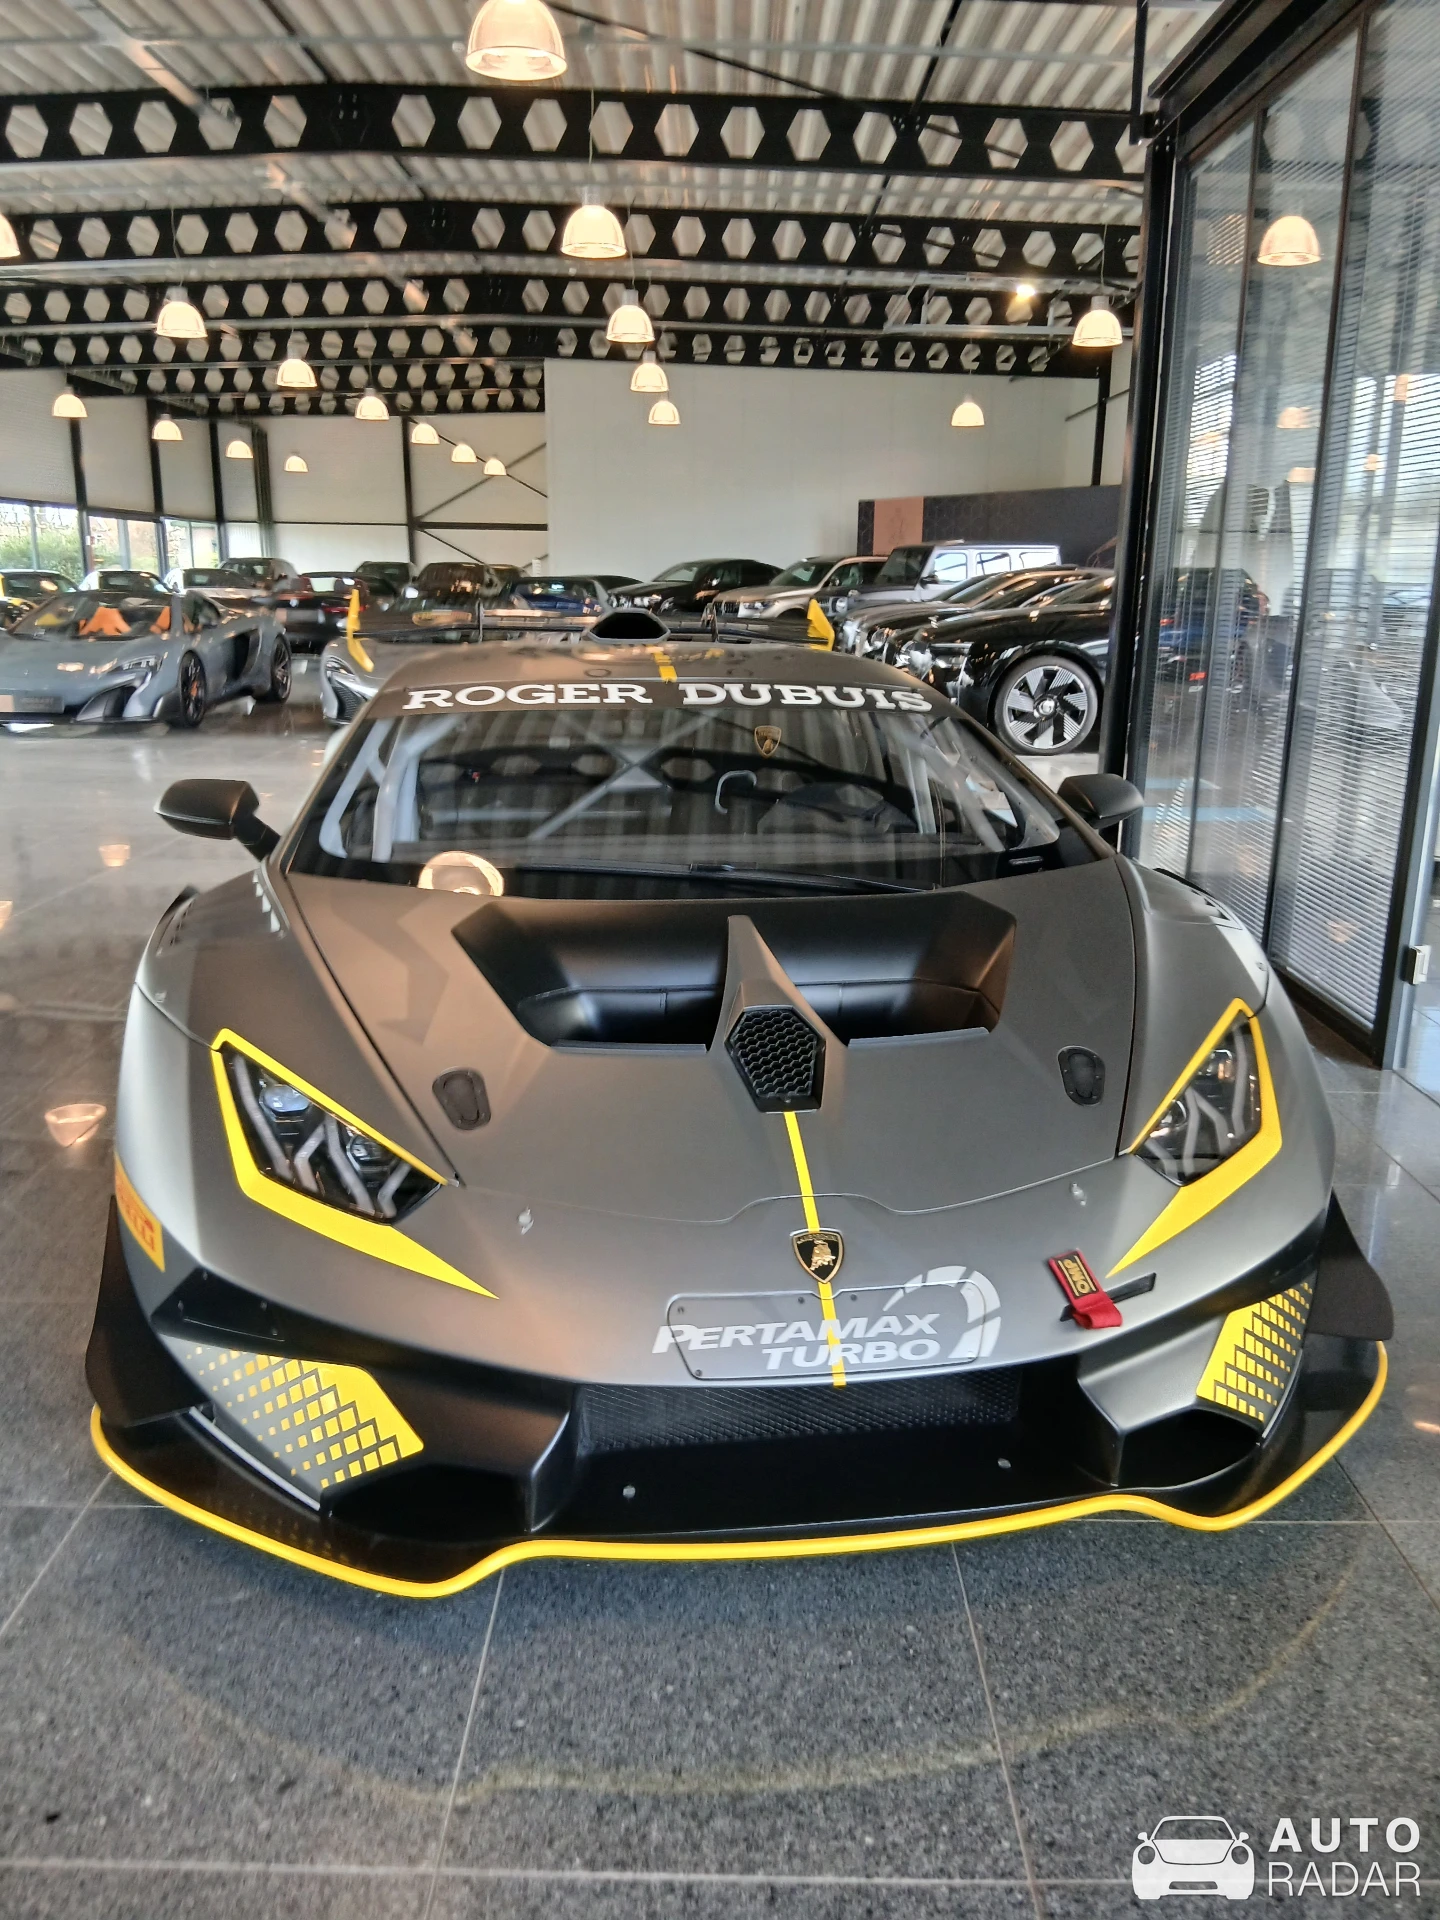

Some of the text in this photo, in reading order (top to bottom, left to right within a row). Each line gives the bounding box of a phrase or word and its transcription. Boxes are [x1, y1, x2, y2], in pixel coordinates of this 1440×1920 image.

[402, 682, 933, 712] ROGER DUBUIS
[1063, 1259, 1091, 1294] OMP
[652, 1313, 941, 1354] PERTAMAX
[762, 1338, 940, 1371] TURBO
